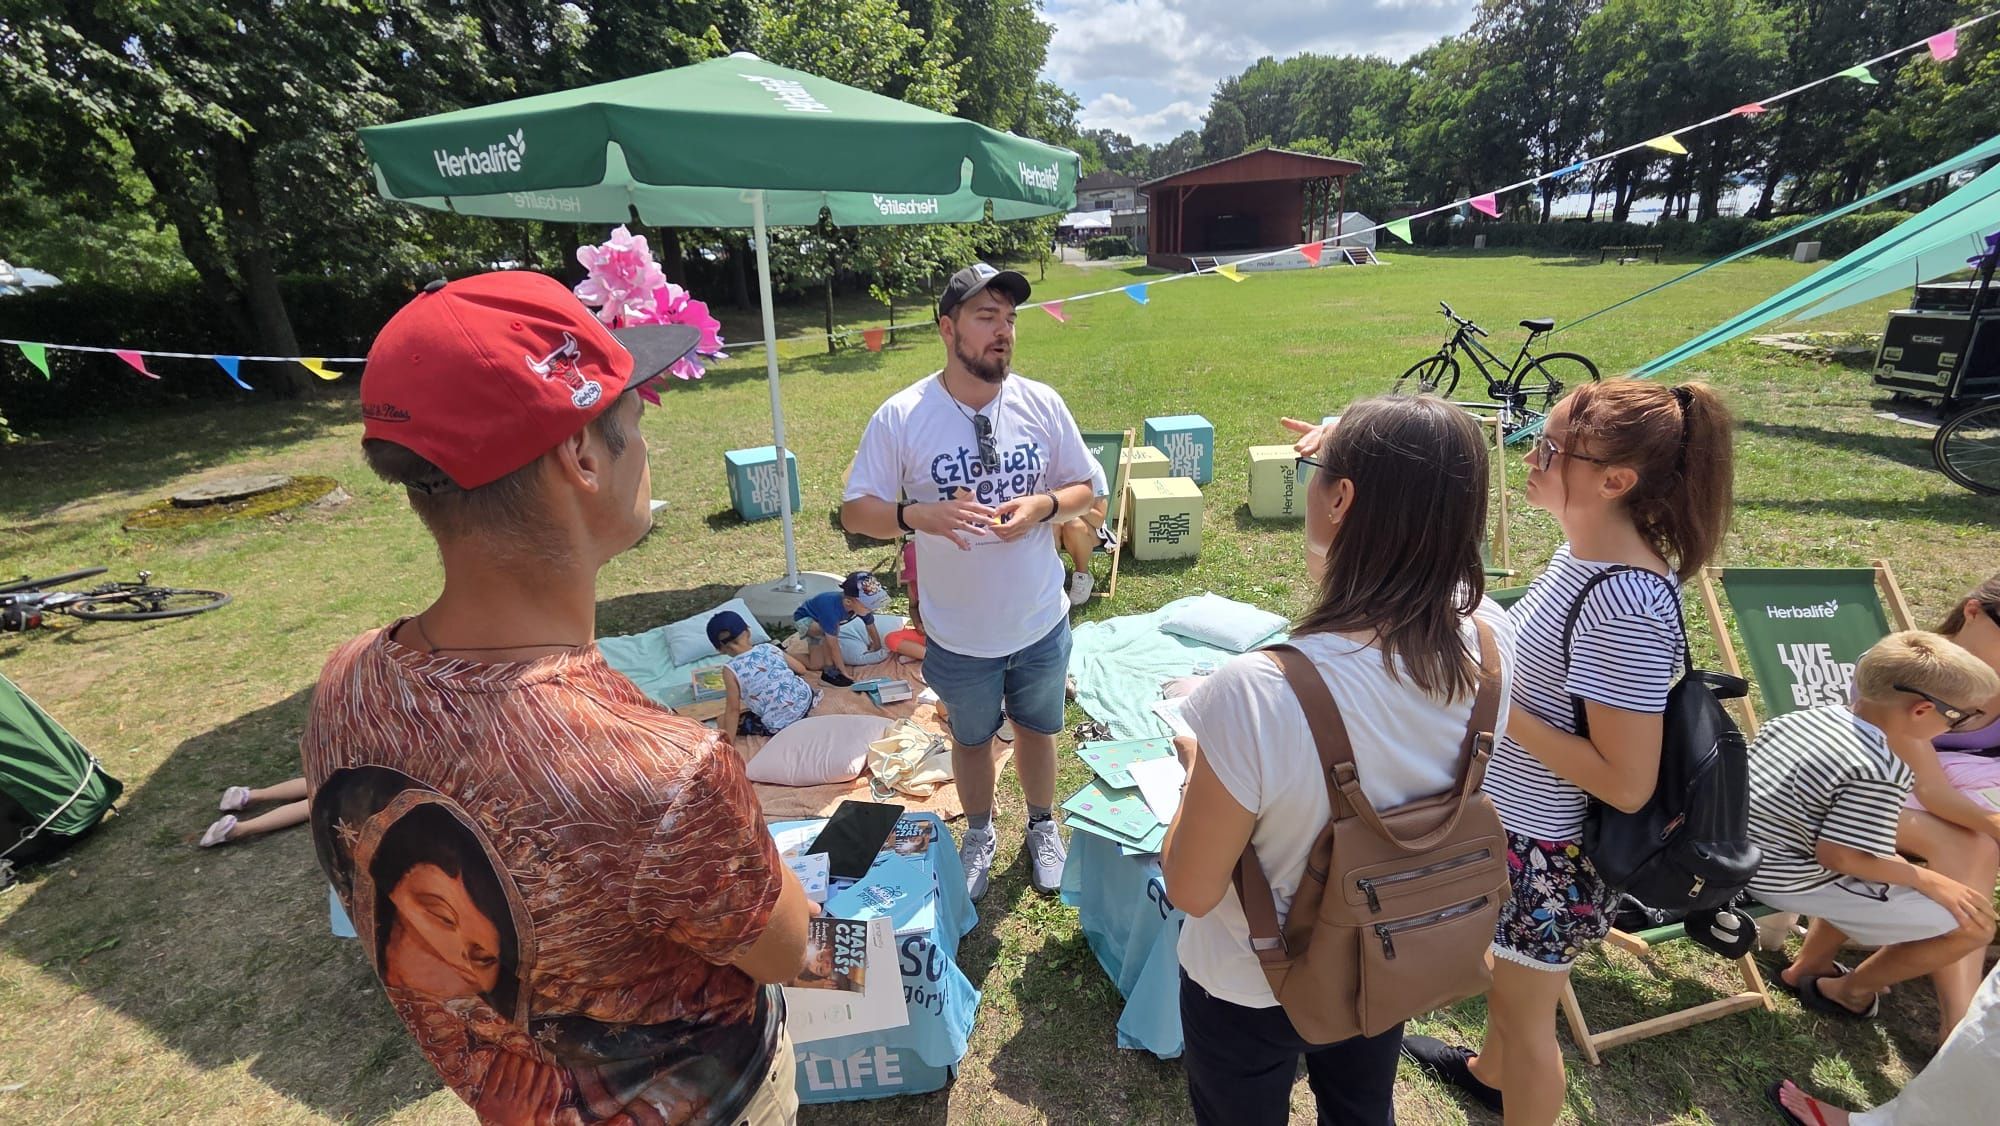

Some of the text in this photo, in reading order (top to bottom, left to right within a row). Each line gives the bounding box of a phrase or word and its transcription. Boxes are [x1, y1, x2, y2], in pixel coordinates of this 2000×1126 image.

[433, 142, 521, 178] Herbalife
[1018, 160, 1058, 192] Herbalife
[1911, 335, 1944, 344] QSC
[1163, 432, 1193, 449] LIVE
[1167, 443, 1204, 460] YOUR
[746, 463, 777, 480] LIVE
[751, 473, 780, 492] YOU
[751, 487, 780, 504] BES
[1282, 468, 1295, 515] Herbalife
[761, 499, 782, 515] LIF
[1148, 520, 1160, 544] LIFE
[1159, 514, 1171, 542] BEST
[1168, 516, 1181, 545] YOUR
[1179, 512, 1190, 536] LIVE
[1766, 604, 1835, 619] Herbalife
[1777, 643, 1836, 664] LIVE
[1787, 661, 1857, 687] YOUR
[1790, 683, 1852, 707] BEST
[834, 923, 851, 976] CZAS?
[849, 924, 866, 969] MASZ
[804, 1045, 904, 1091] LIFE
